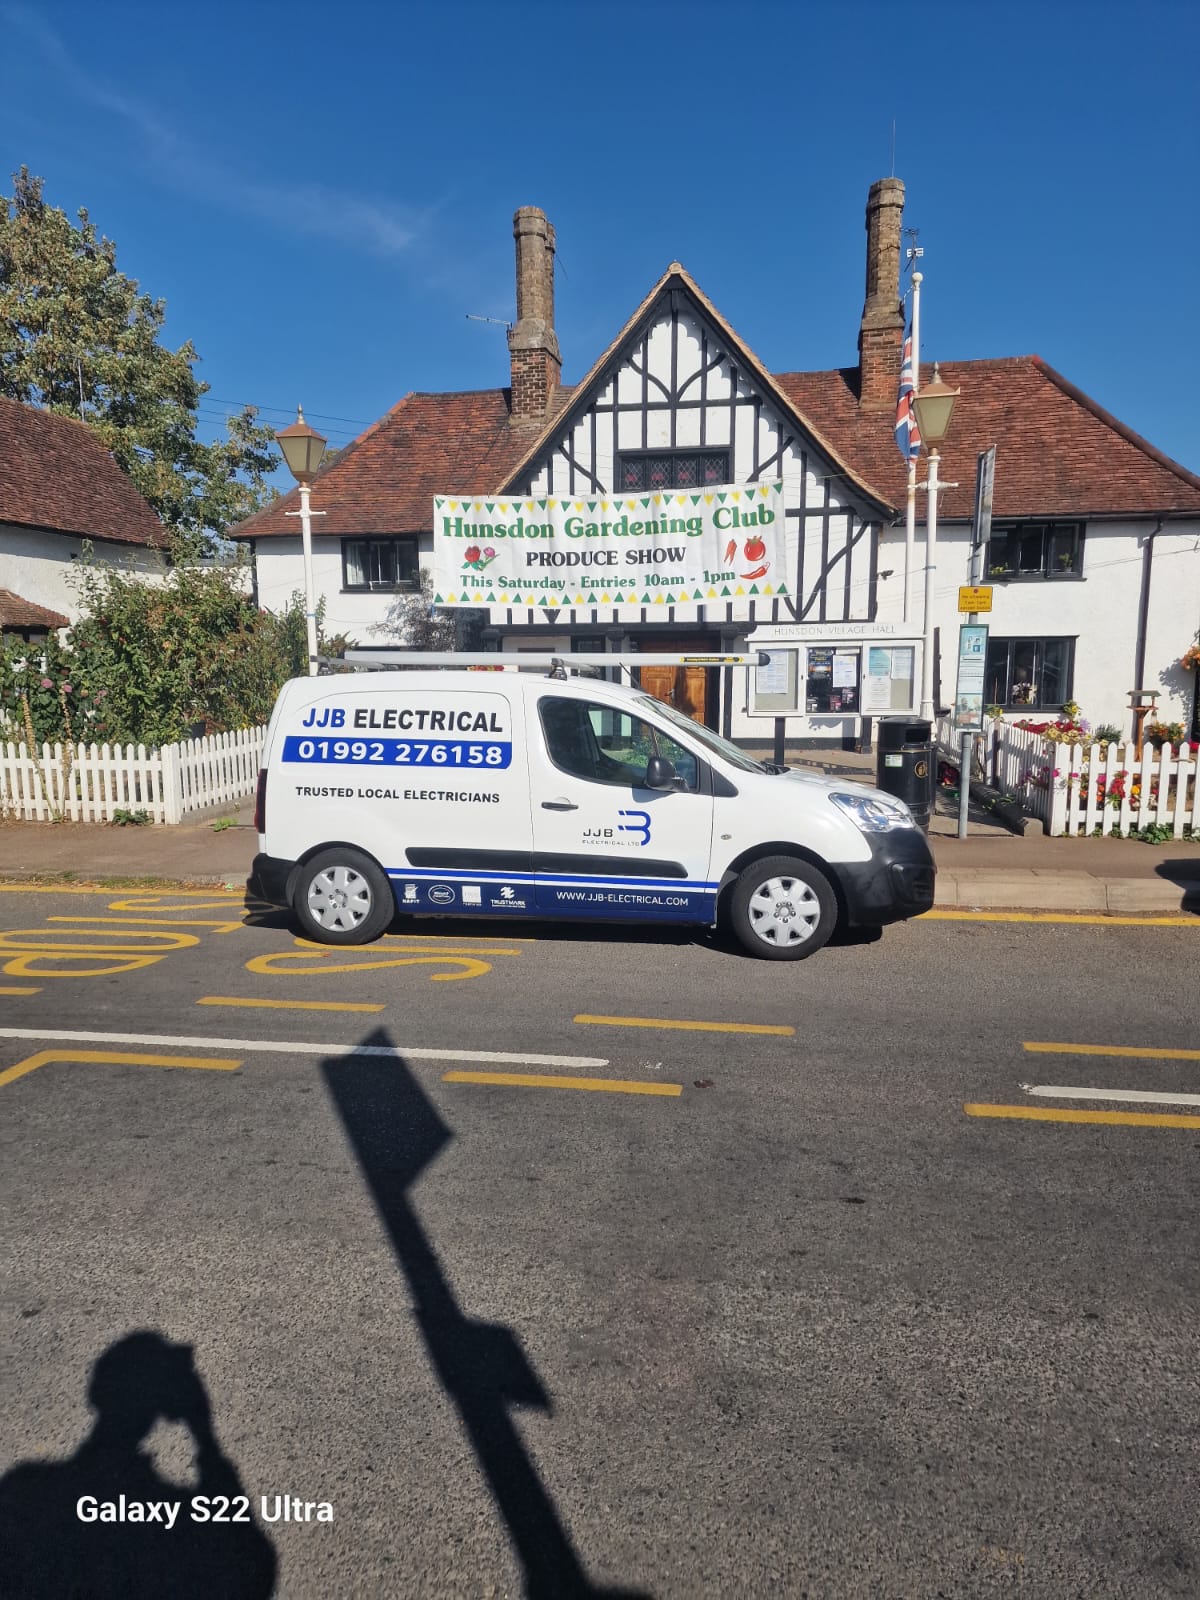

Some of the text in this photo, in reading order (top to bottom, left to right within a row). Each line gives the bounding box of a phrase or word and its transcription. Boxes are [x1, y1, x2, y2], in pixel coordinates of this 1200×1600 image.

[443, 503, 775, 538] Hunsdon Gardening Club
[526, 547, 686, 567] PRODUCE SHOW
[460, 575, 493, 589] This
[498, 575, 565, 591] Saturday
[581, 575, 636, 588] Entries
[644, 573, 685, 587] 10am
[703, 570, 736, 585] 1pm
[774, 625, 895, 636] HUNSDON VILLAGE HALL
[302, 708, 503, 732] JJB ELECTRICAL
[298, 741, 502, 765] 01992 276158
[295, 787, 500, 803] TRUSTED LOCAL ELECTRICIANS
[583, 828, 613, 837] JJB
[556, 892, 689, 906] WWW.JJB-ELECTRICAL.COM
